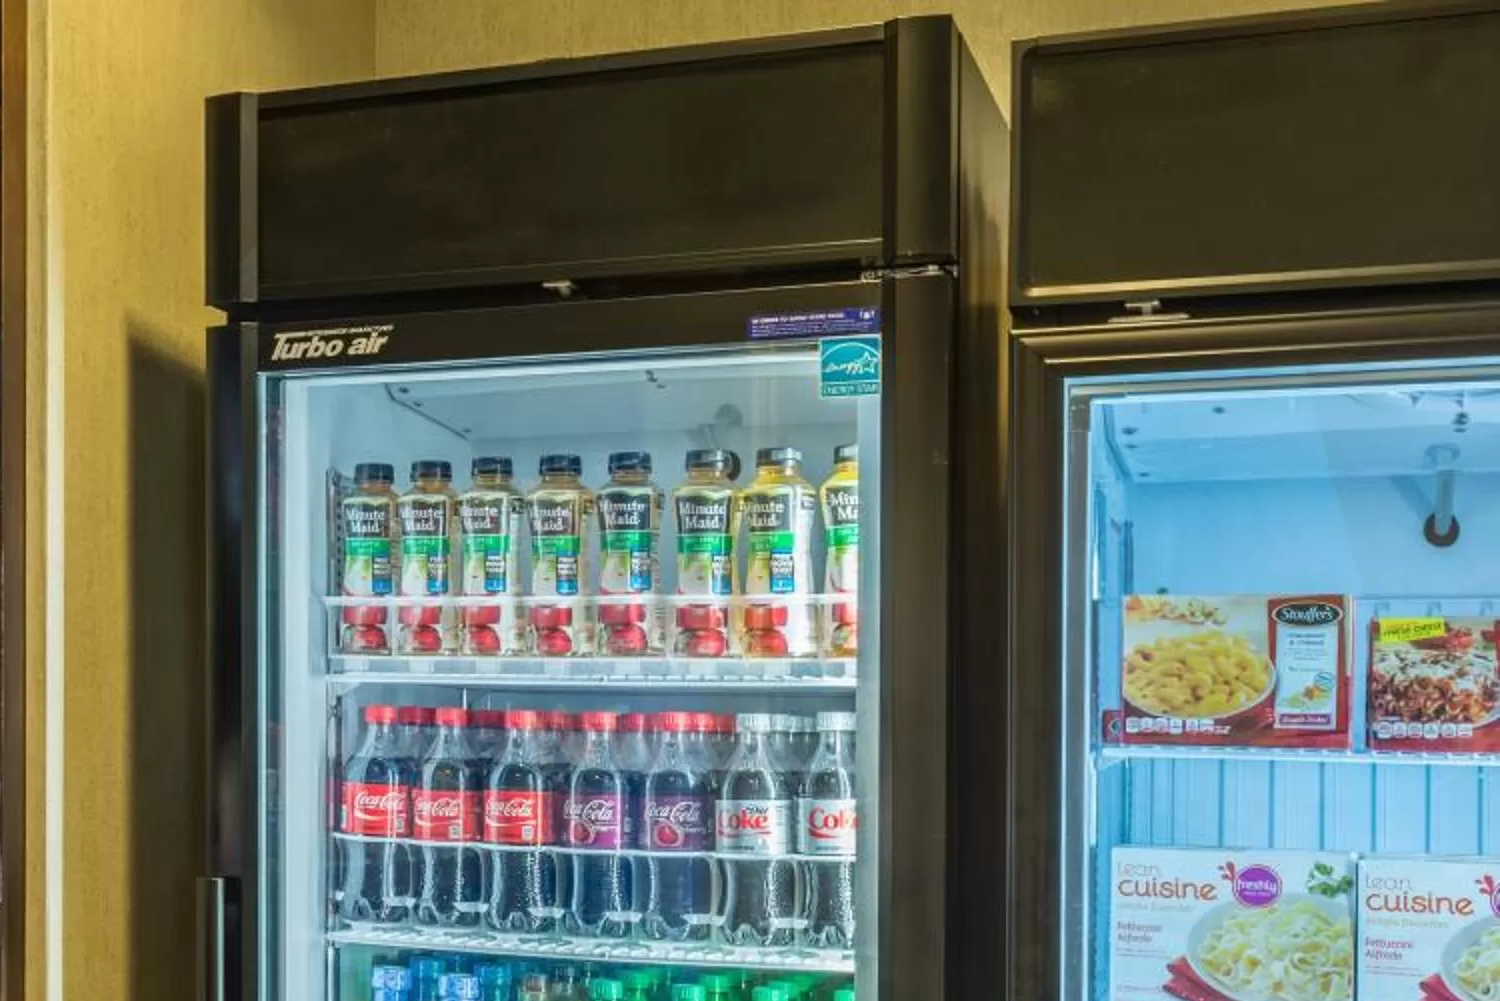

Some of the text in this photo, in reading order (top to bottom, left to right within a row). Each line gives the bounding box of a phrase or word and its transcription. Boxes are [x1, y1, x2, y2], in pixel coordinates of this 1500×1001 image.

[271, 330, 389, 361] Turbo air
[829, 492, 859, 508] Min
[679, 501, 726, 516] Minute
[837, 506, 859, 521] Ma
[685, 513, 723, 529] Maid
[1280, 605, 1333, 622] Stouffer's
[1117, 877, 1218, 901] cuisine
[1365, 891, 1475, 915] cuisine
